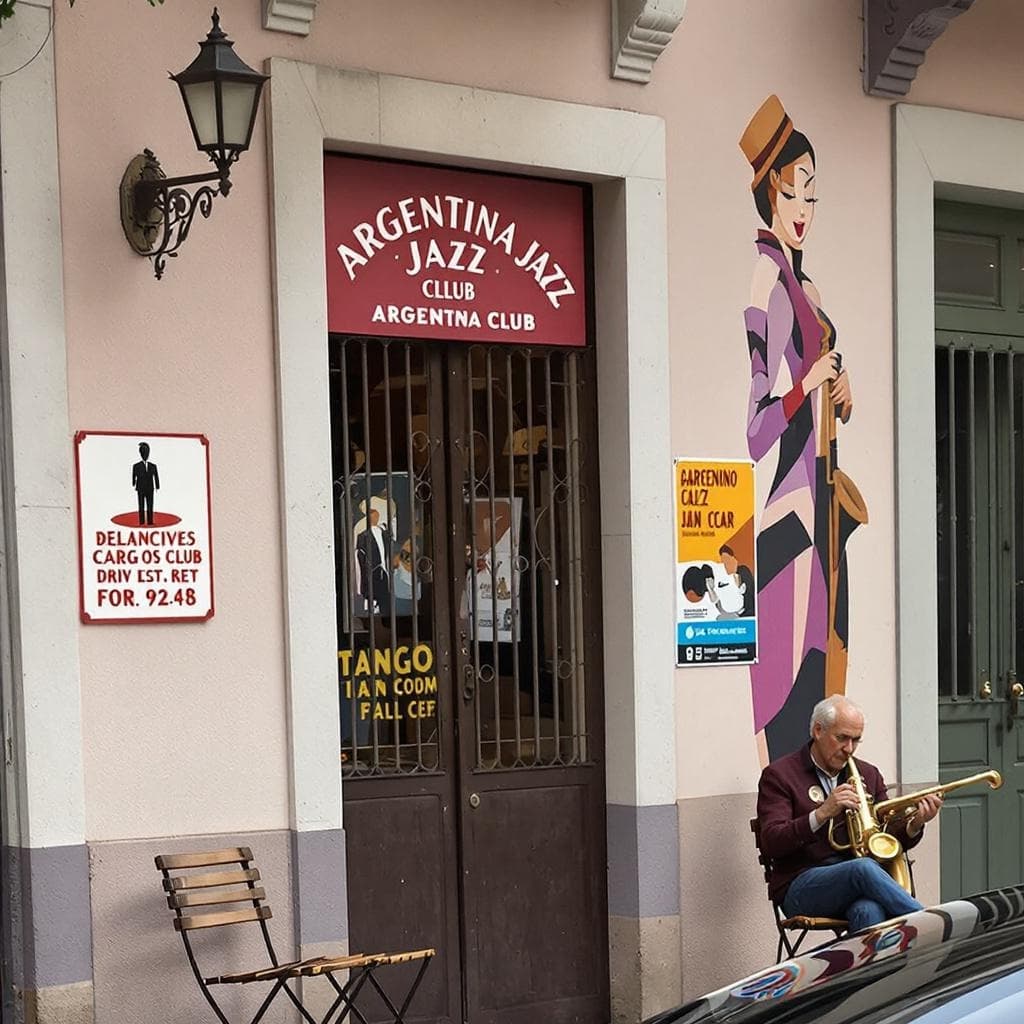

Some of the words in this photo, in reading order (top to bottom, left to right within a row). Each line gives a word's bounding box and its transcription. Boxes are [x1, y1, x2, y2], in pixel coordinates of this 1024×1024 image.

[337, 195, 516, 281] ARGENTINA
[514, 241, 576, 309] JAZZ
[405, 239, 487, 276] JAZZ
[422, 279, 475, 301] CLLUB
[371, 304, 482, 328] ARGENTNA
[487, 311, 536, 331] CLUB
[96, 531, 196, 547] DELANCIVES
[165, 549, 203, 564] CLUB
[96, 569, 132, 584] DRIV
[171, 569, 199, 583] RET
[97, 589, 140, 607] FOR.
[337, 644, 433, 676] TANGO
